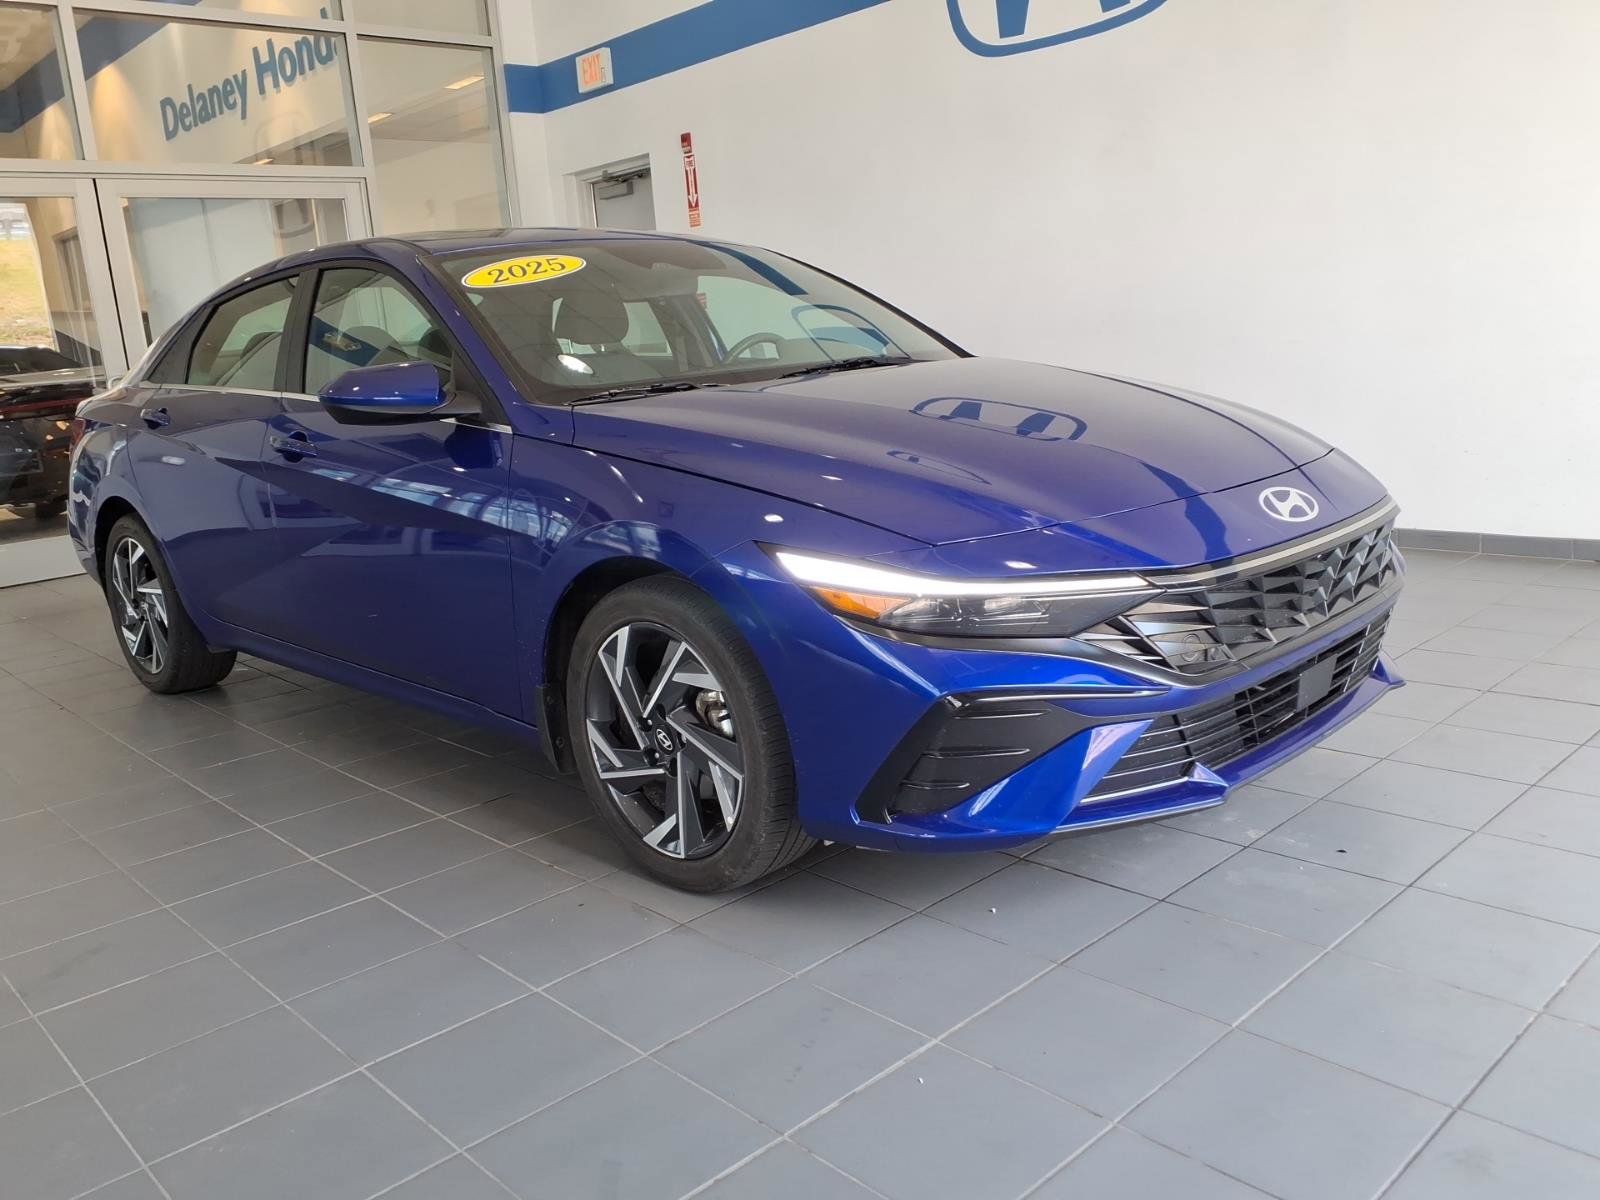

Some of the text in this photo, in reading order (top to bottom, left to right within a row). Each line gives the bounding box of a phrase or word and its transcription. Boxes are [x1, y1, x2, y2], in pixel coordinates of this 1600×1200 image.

[160, 7, 338, 141] Delaney Hond
[581, 53, 601, 85] EXIT
[487, 257, 566, 284] 2025
